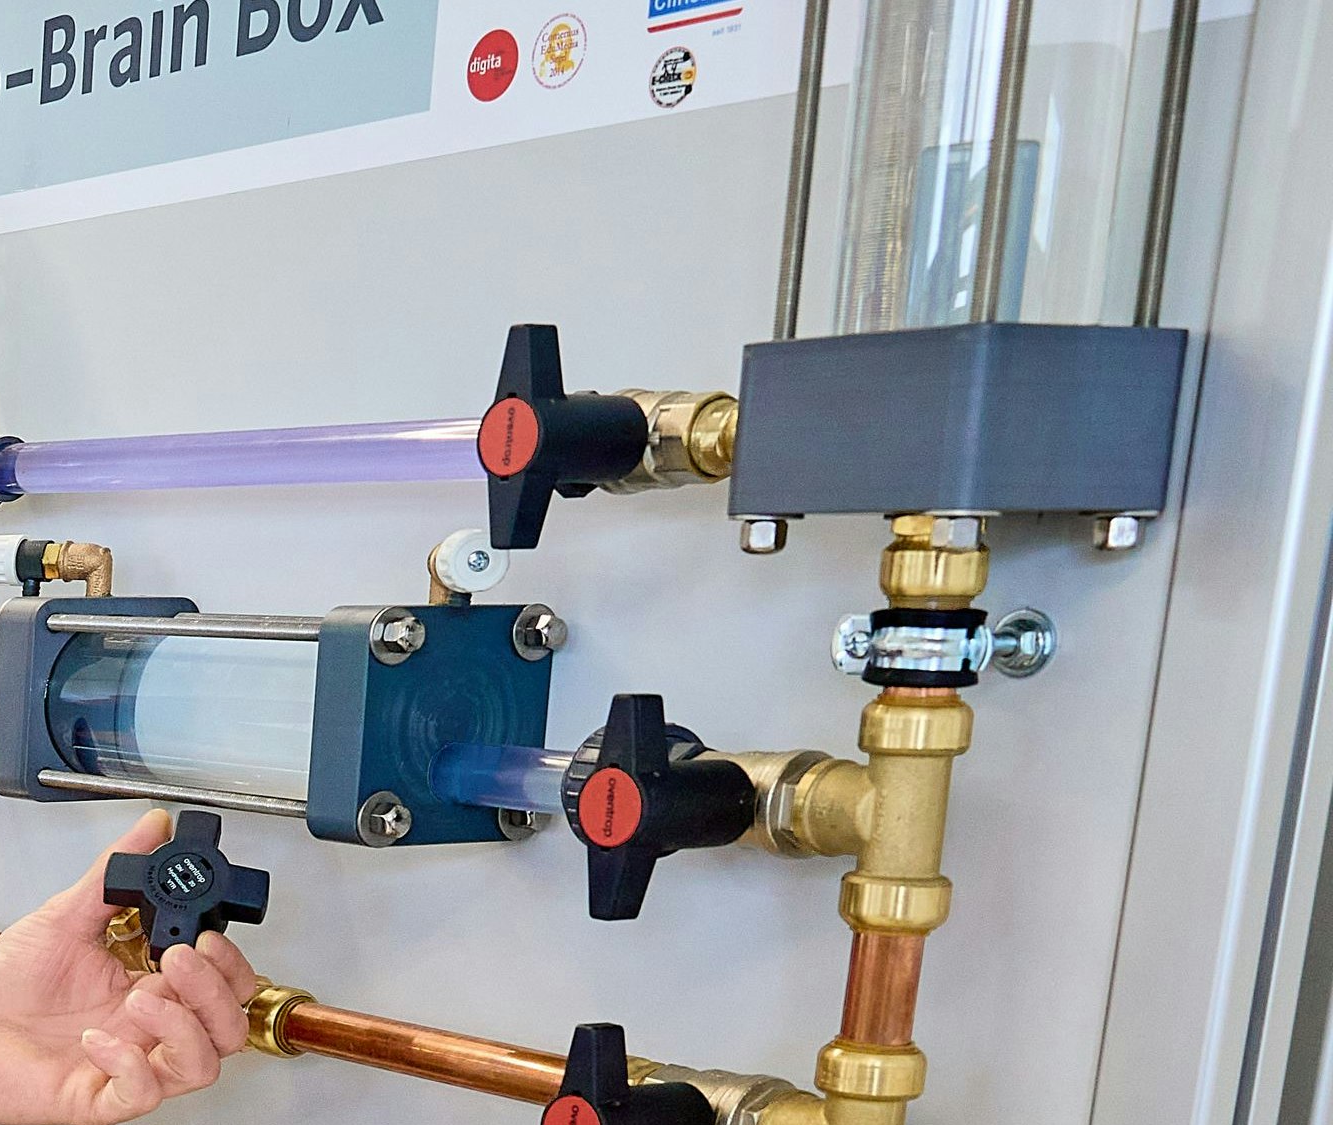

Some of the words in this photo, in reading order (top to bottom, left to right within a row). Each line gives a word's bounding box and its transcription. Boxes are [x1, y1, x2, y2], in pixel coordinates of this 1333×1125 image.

[469, 53, 502, 75] digita
[502, 406, 516, 467] oventrop
[602, 777, 616, 838] oventrop
[184, 858, 205, 883] oventrop
